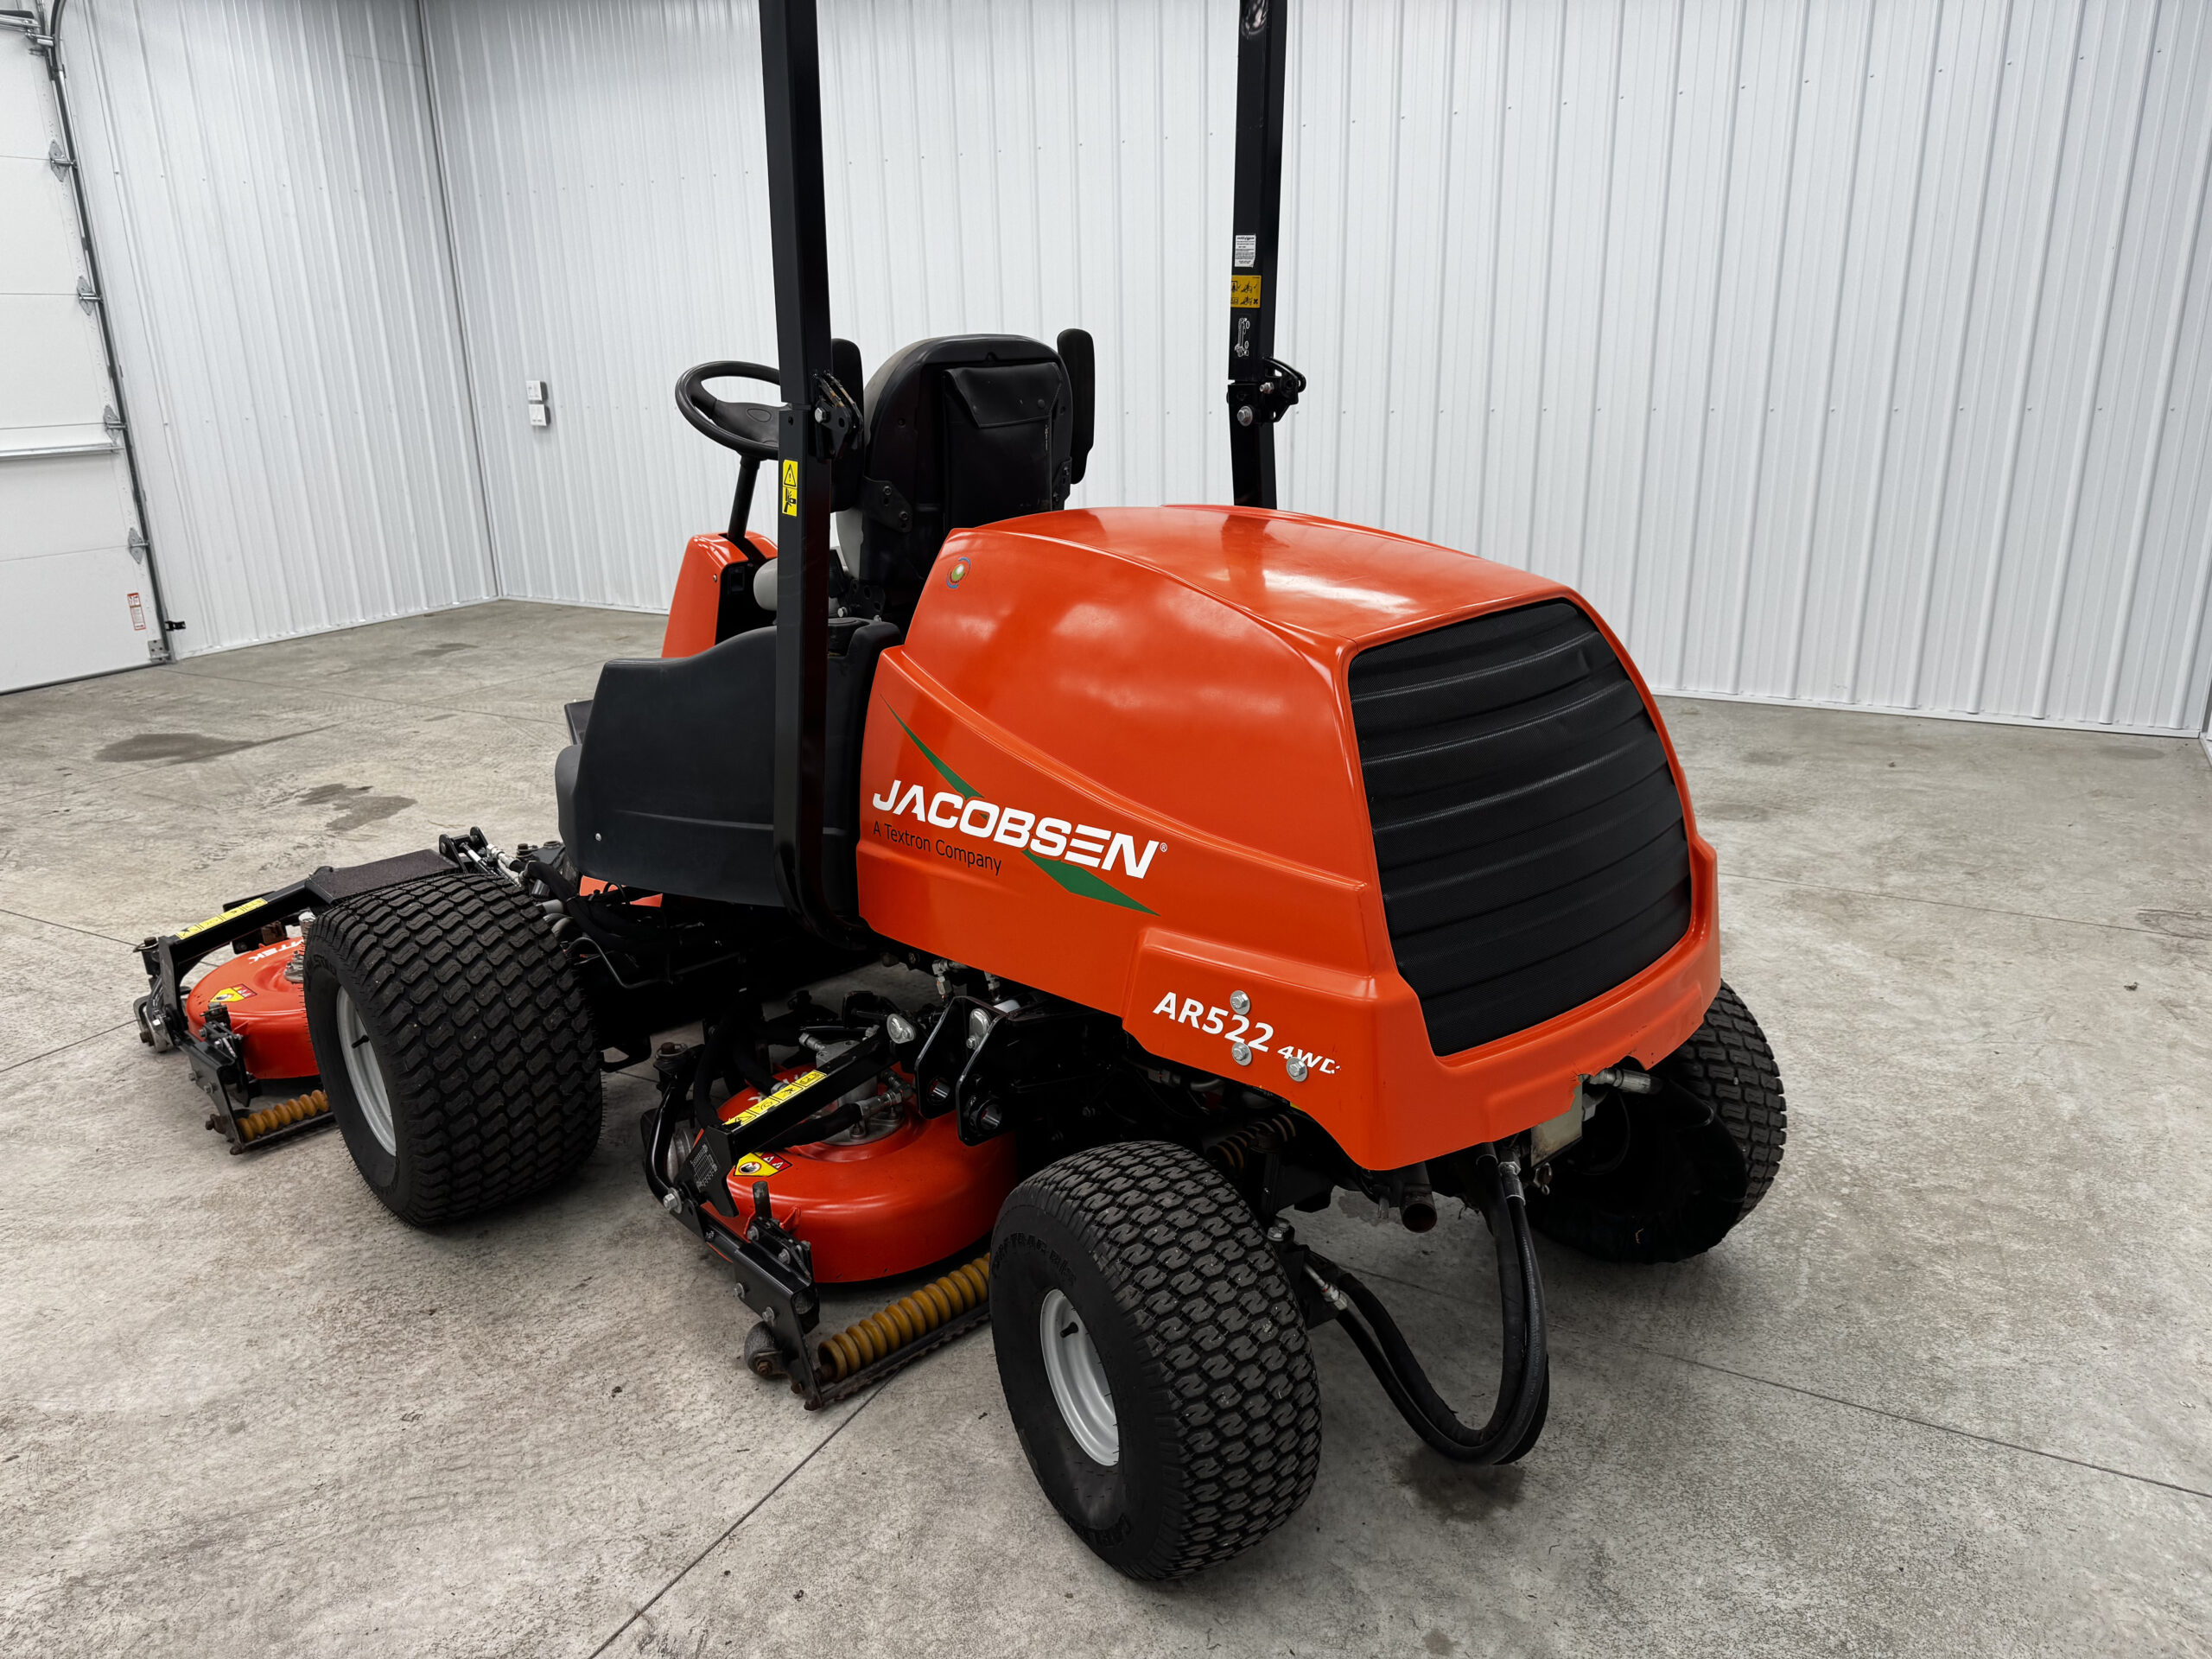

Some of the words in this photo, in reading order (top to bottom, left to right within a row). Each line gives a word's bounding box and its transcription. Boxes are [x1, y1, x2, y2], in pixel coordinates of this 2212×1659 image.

[873, 779, 1160, 879] JACOBSEN
[873, 821, 881, 836] A
[884, 823, 931, 852] Textron
[936, 839, 1002, 876] Company
[1153, 991, 1274, 1052] AR522
